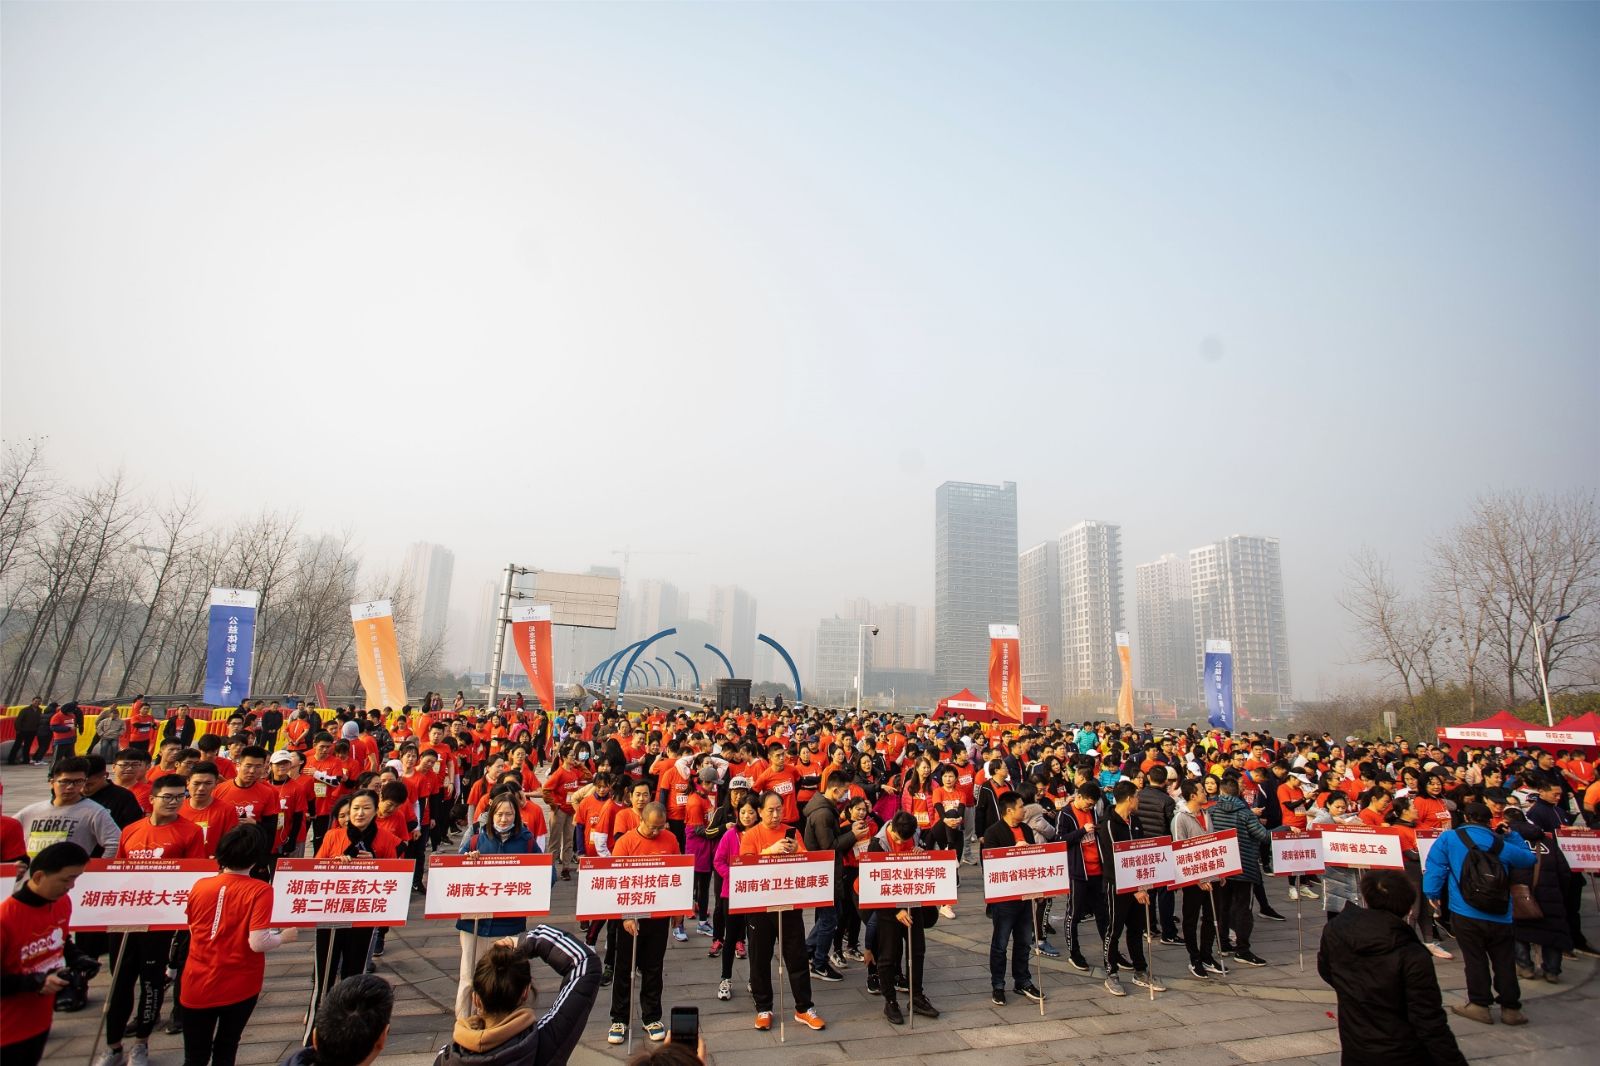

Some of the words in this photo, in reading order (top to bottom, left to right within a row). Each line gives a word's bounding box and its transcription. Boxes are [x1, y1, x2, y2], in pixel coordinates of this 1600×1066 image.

[31, 819, 79, 832] DEGREE
[1175, 845, 1228, 866] 湖南省粮食和
[1281, 849, 1317, 861] 湖南省体育局
[1329, 842, 1388, 855] 湖南省总工会
[1120, 852, 1168, 869] 湖南省退役军人
[1181, 858, 1225, 877] 物资储备局
[591, 874, 682, 890] 湖南省科技信息
[869, 867, 947, 882] 中国农业科学院
[988, 864, 1064, 884] 湖南省科学技术厅
[1135, 867, 1156, 881] 事务厅
[286, 879, 398, 895] 湖南中医药大学
[446, 881, 532, 897] 湖南女子学院
[734, 874, 830, 893] 湖南省卫生健康委
[880, 882, 936, 896] 麻类研究所
[80, 889, 189, 907] 湖南科技大学
[290, 897, 387, 913] 第二附属医院
[616, 891, 656, 905] 研究所
